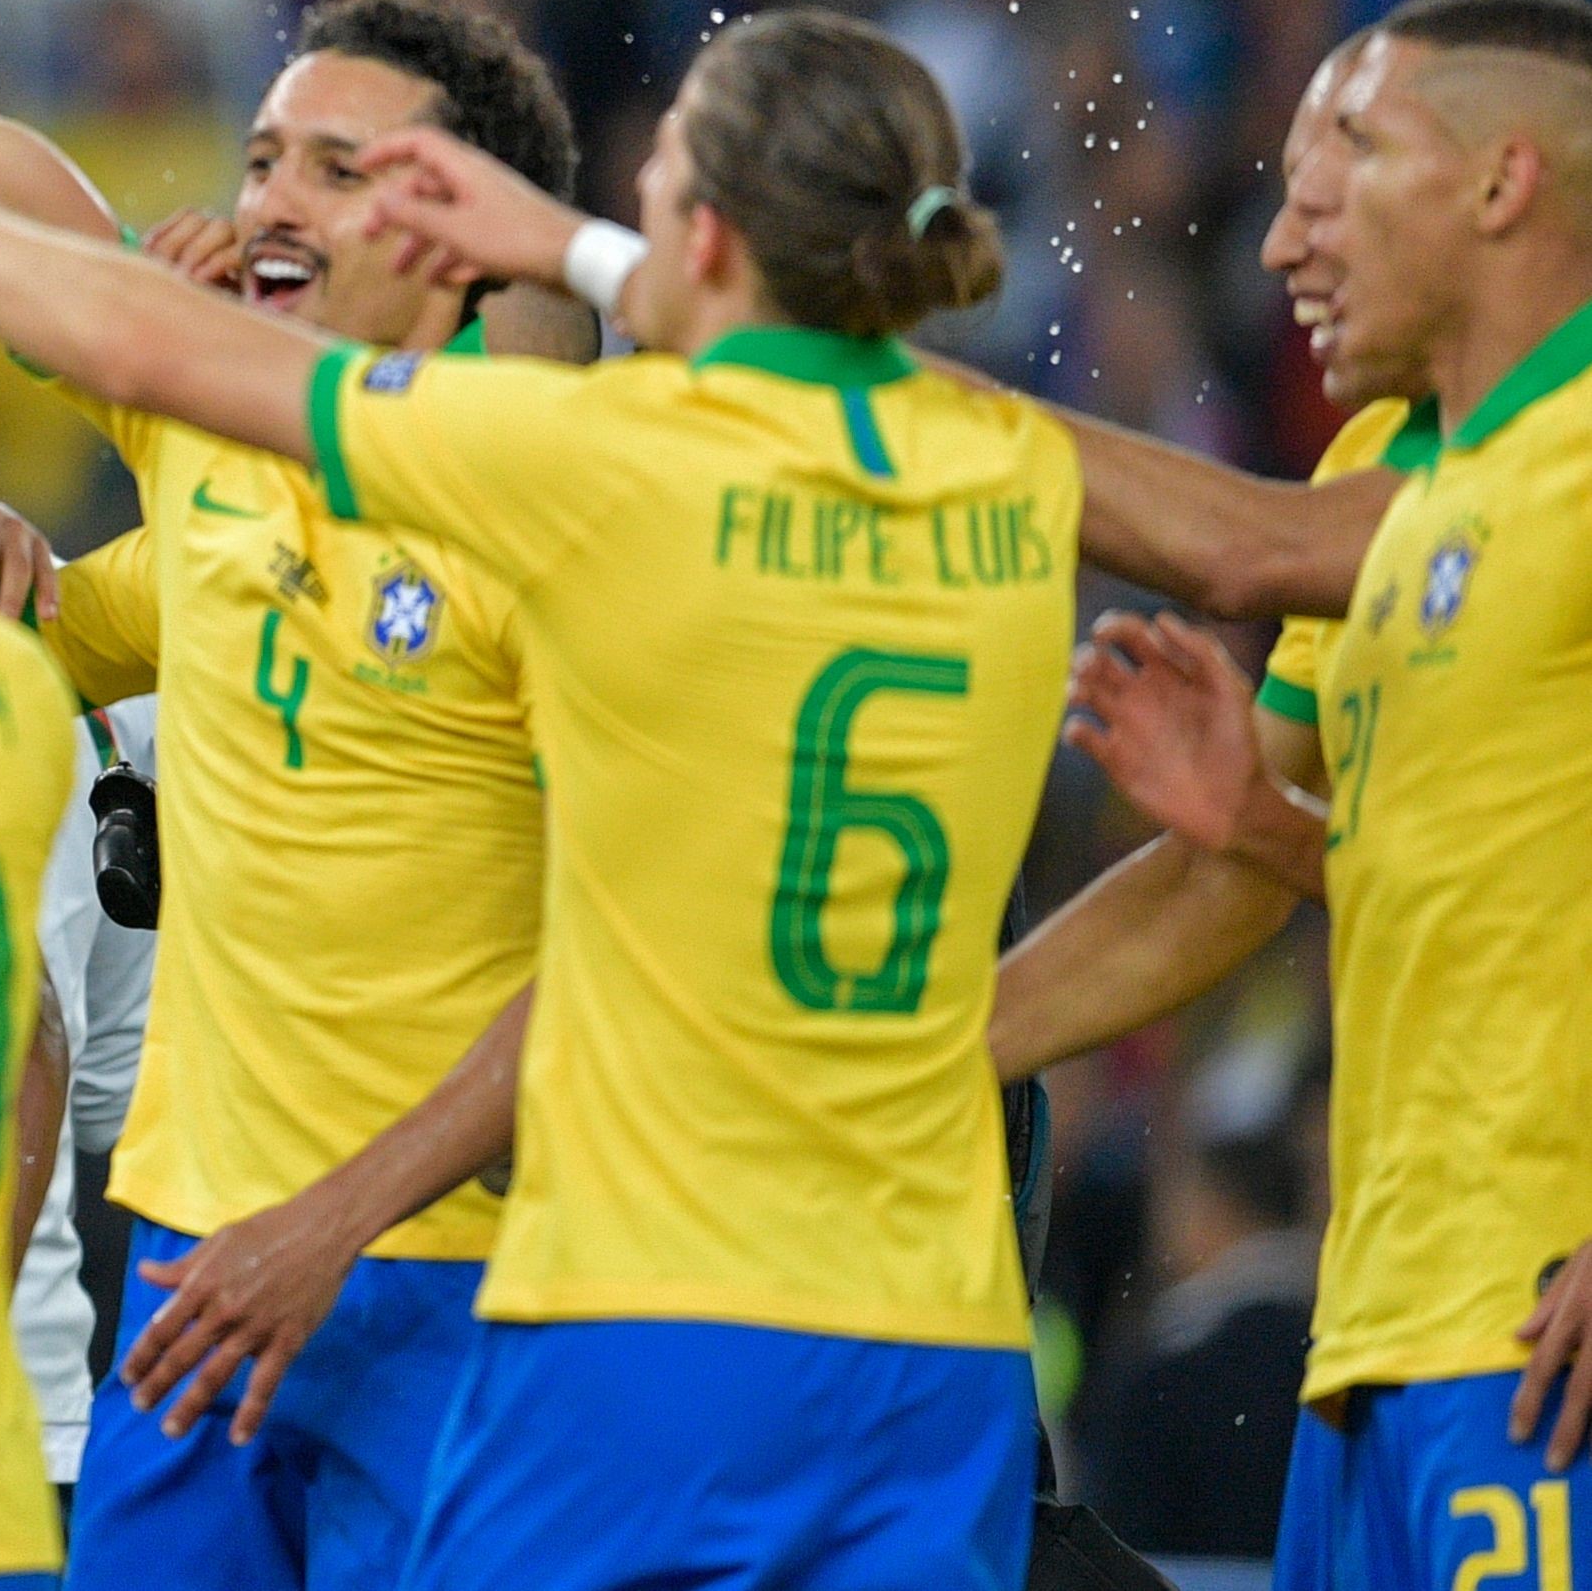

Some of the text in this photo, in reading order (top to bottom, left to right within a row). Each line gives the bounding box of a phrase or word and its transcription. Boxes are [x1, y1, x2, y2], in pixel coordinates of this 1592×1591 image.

[714, 482, 1052, 589] FILIPE LUIS
[253, 608, 310, 771] 4
[767, 645, 971, 1015] 6
[1449, 1479, 1572, 1591] 21
